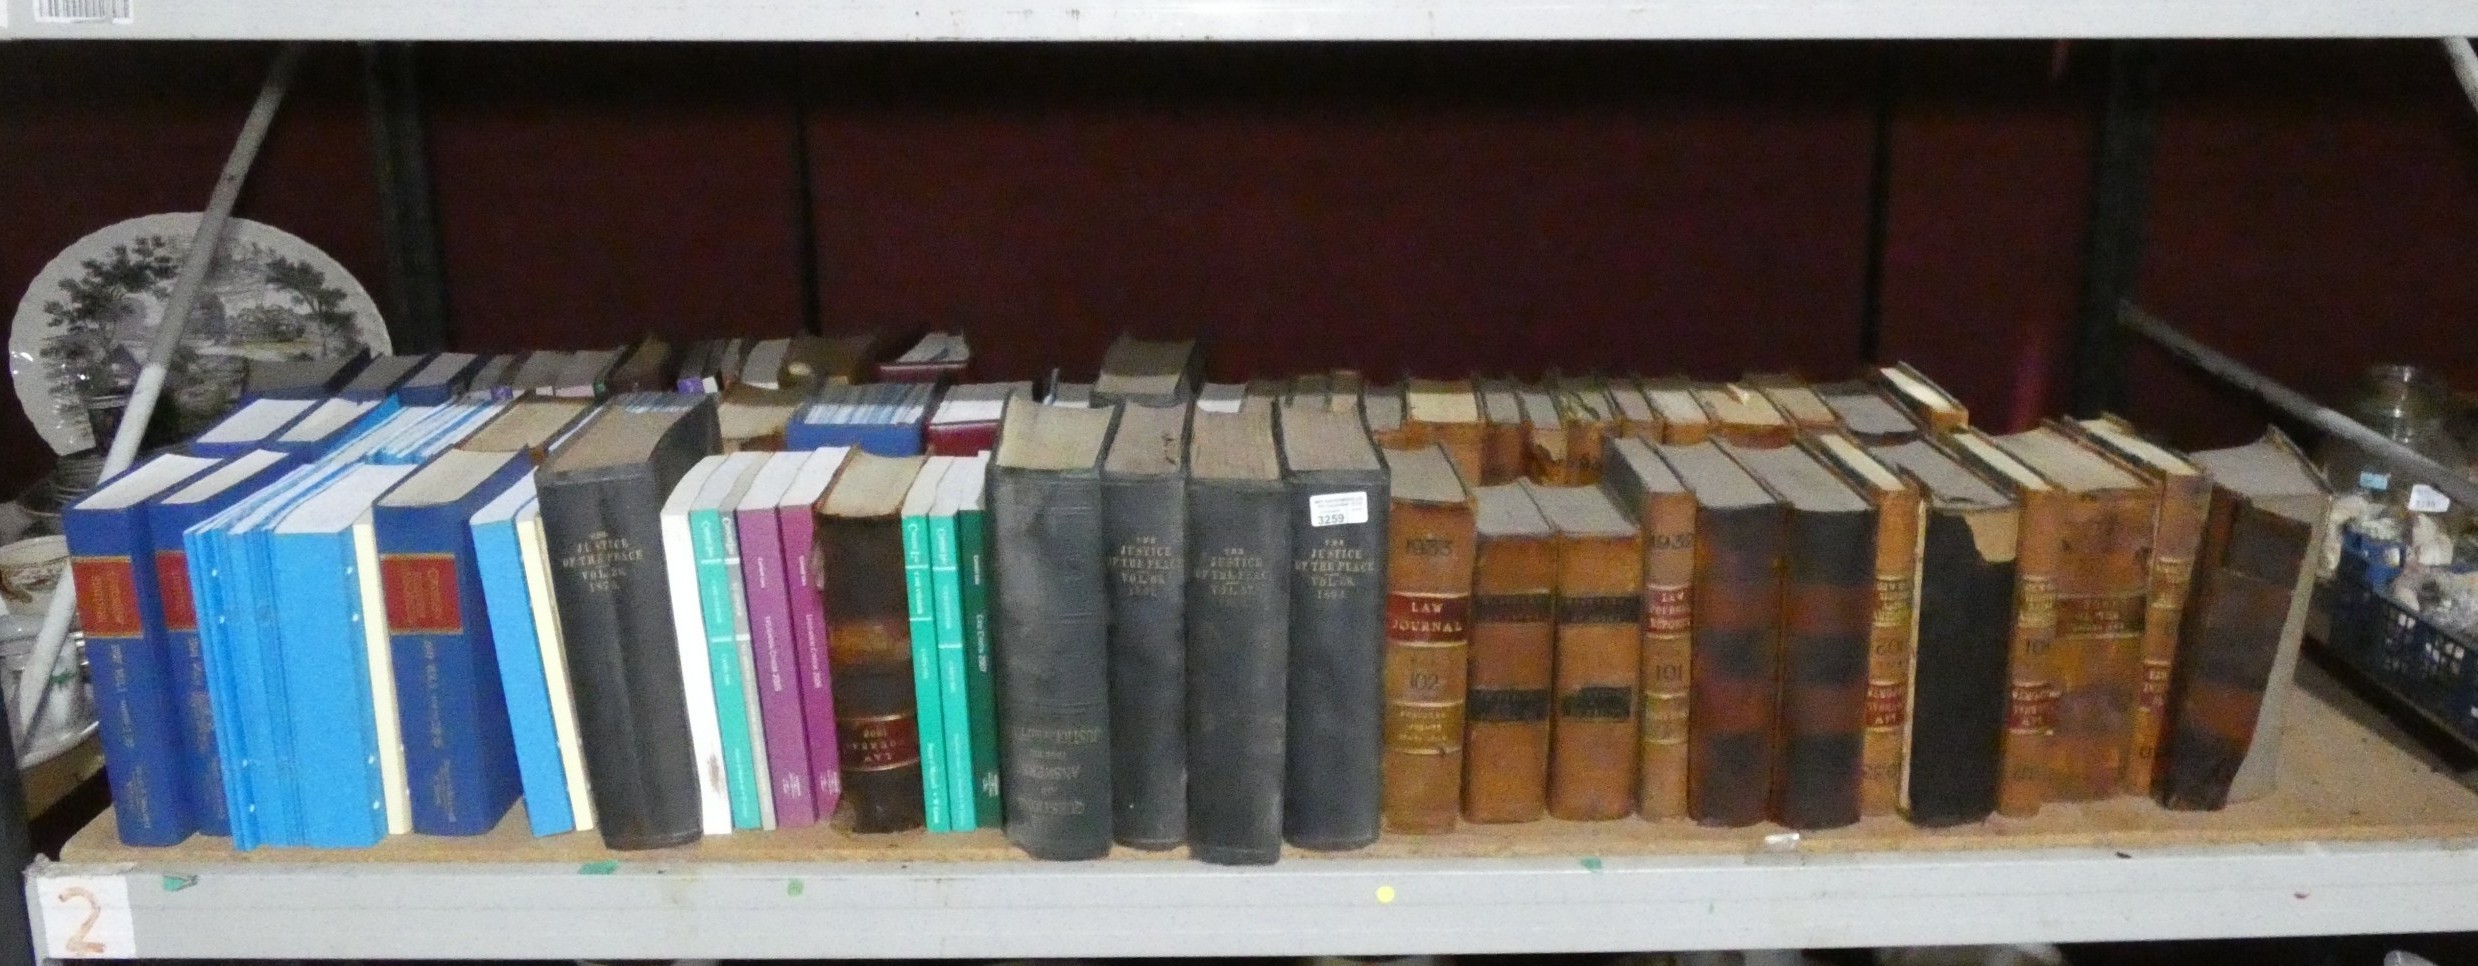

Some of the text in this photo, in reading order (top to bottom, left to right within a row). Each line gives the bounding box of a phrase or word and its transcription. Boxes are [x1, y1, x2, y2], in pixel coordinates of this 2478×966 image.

[1317, 513, 1345, 525] 3259
[1311, 548, 1363, 560] JUSTICE
[1410, 601, 1443, 614] LAW
[1392, 618, 1462, 633] JOURNAL
[1410, 672, 1438, 690] 102
[863, 752, 892, 763] LAW
[57, 886, 106, 954] 2
